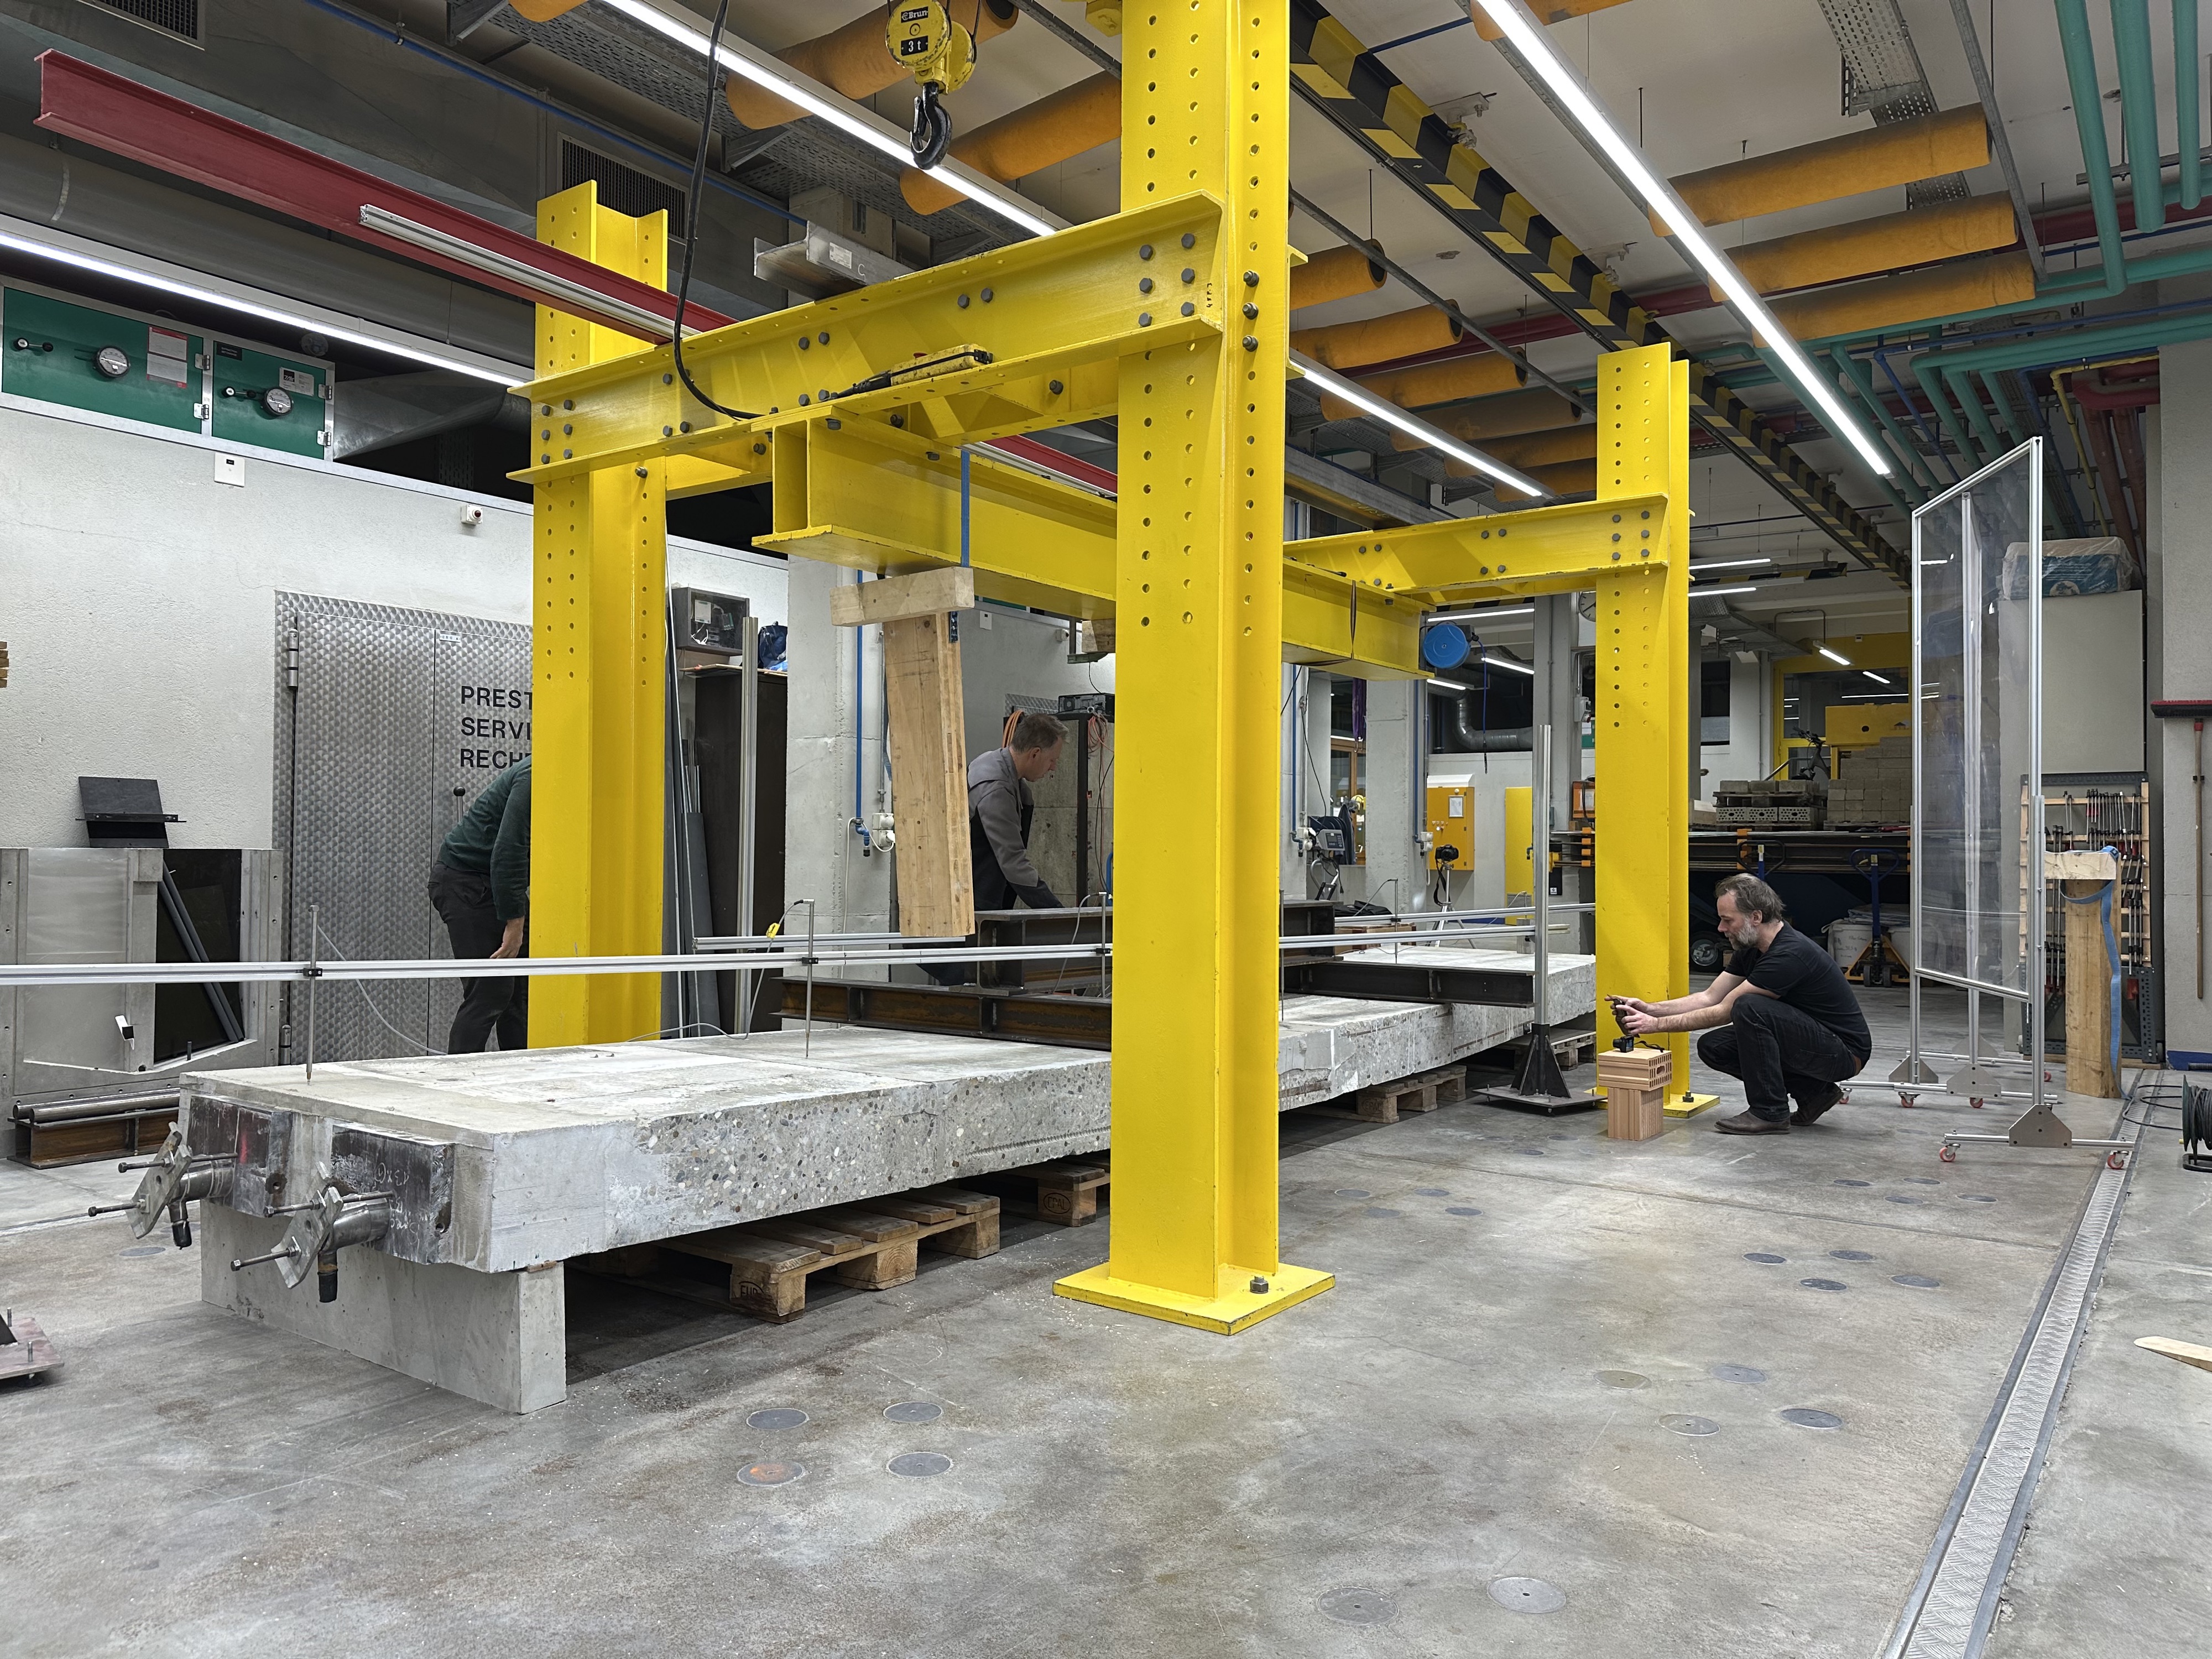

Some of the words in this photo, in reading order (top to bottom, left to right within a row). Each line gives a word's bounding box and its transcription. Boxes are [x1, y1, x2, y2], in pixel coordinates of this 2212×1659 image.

[909, 10, 927, 19] Brun
[909, 40, 914, 52] 3
[917, 40, 921, 50] t
[461, 685, 532, 710] PREST
[461, 717, 530, 740] SERVI
[461, 748, 531, 769] RECH
[1047, 1196, 1067, 1211] EPAL
